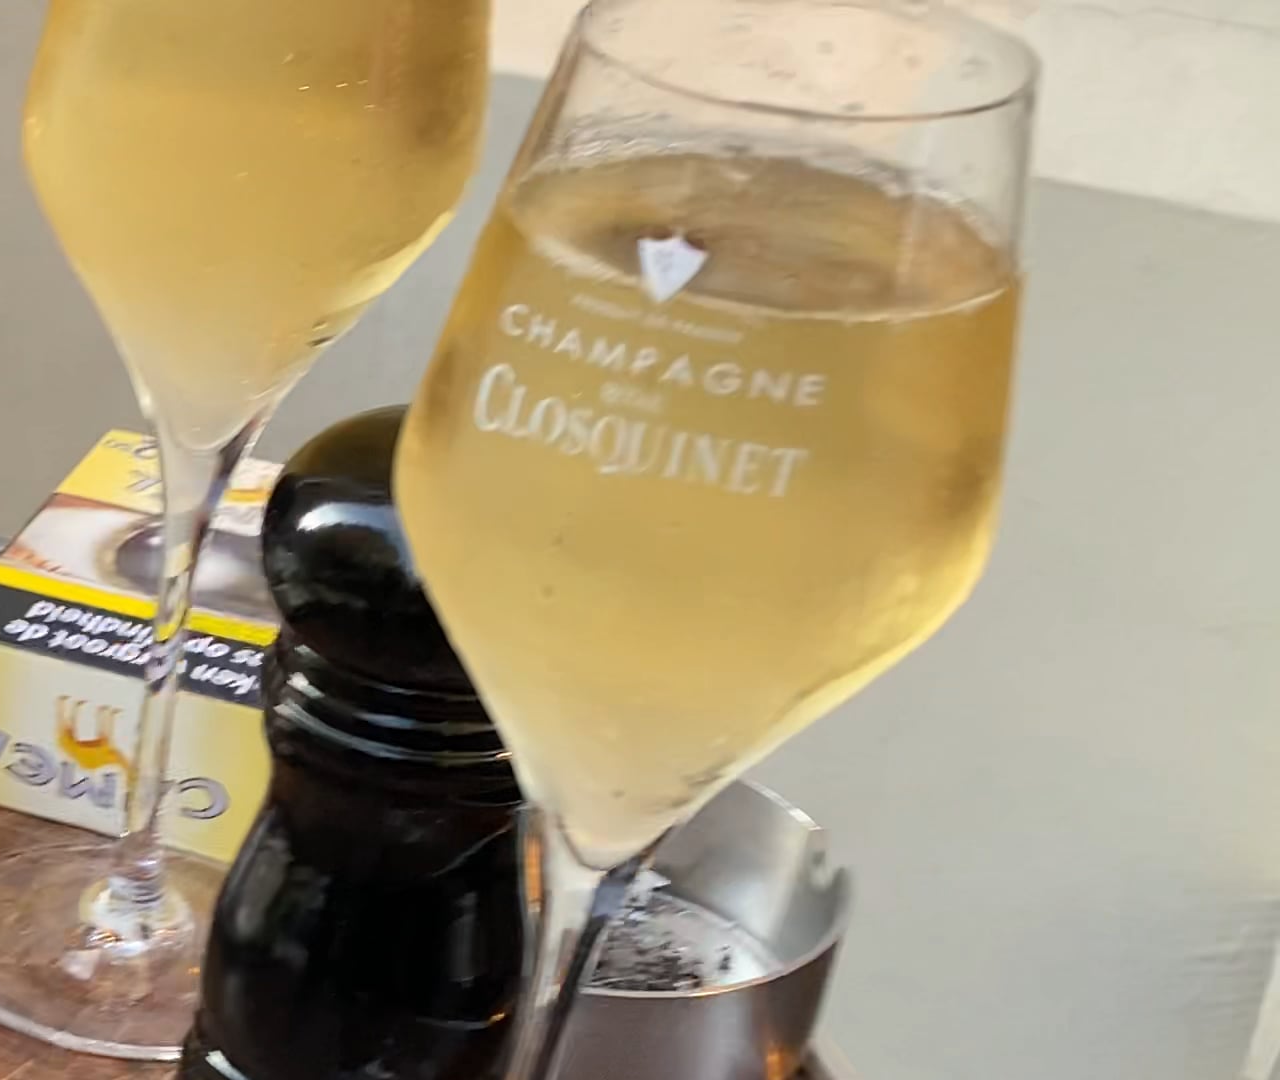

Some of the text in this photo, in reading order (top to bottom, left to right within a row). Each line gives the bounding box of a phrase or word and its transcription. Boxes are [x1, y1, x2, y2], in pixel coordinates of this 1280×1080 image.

[499, 303, 827, 406] CHAMPAGNE
[473, 362, 811, 499] CLOSQUINET
[3, 619, 49, 642] de
[25, 600, 153, 648] lindheid
[190, 663, 262, 696] ken
